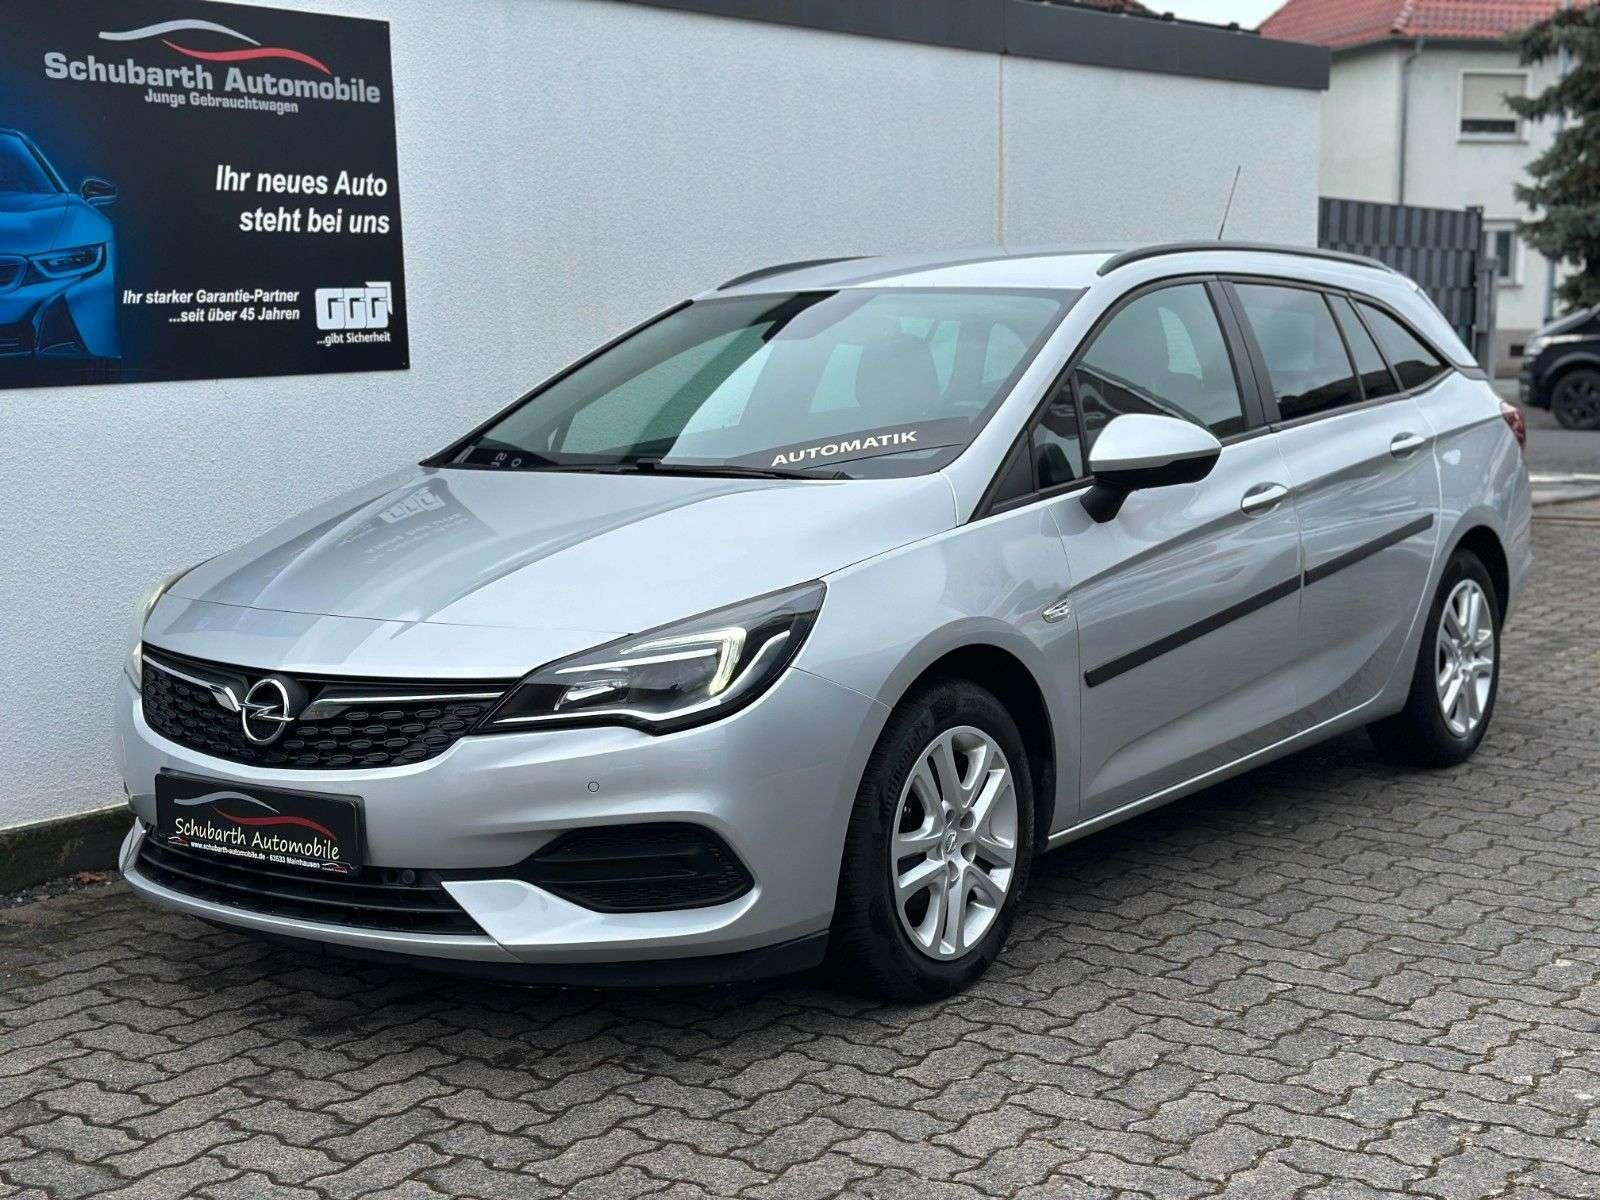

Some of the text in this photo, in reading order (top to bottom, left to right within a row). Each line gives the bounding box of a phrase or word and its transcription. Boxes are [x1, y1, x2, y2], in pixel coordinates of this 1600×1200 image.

[44, 52, 381, 103] Schubarth Automobile
[144, 89, 299, 115] Junge Gebrauchtwagen
[215, 164, 388, 197] Ihr neues Auto
[239, 206, 390, 234] steht bei uns
[122, 289, 300, 304] Ihr starker Garantie-Partner
[168, 307, 301, 323] ...seit über 45 Jahren
[346, 331, 392, 344] Sicherheit
[771, 430, 918, 467] AUTOMATIK
[175, 817, 341, 861] Schubarth Automobile
